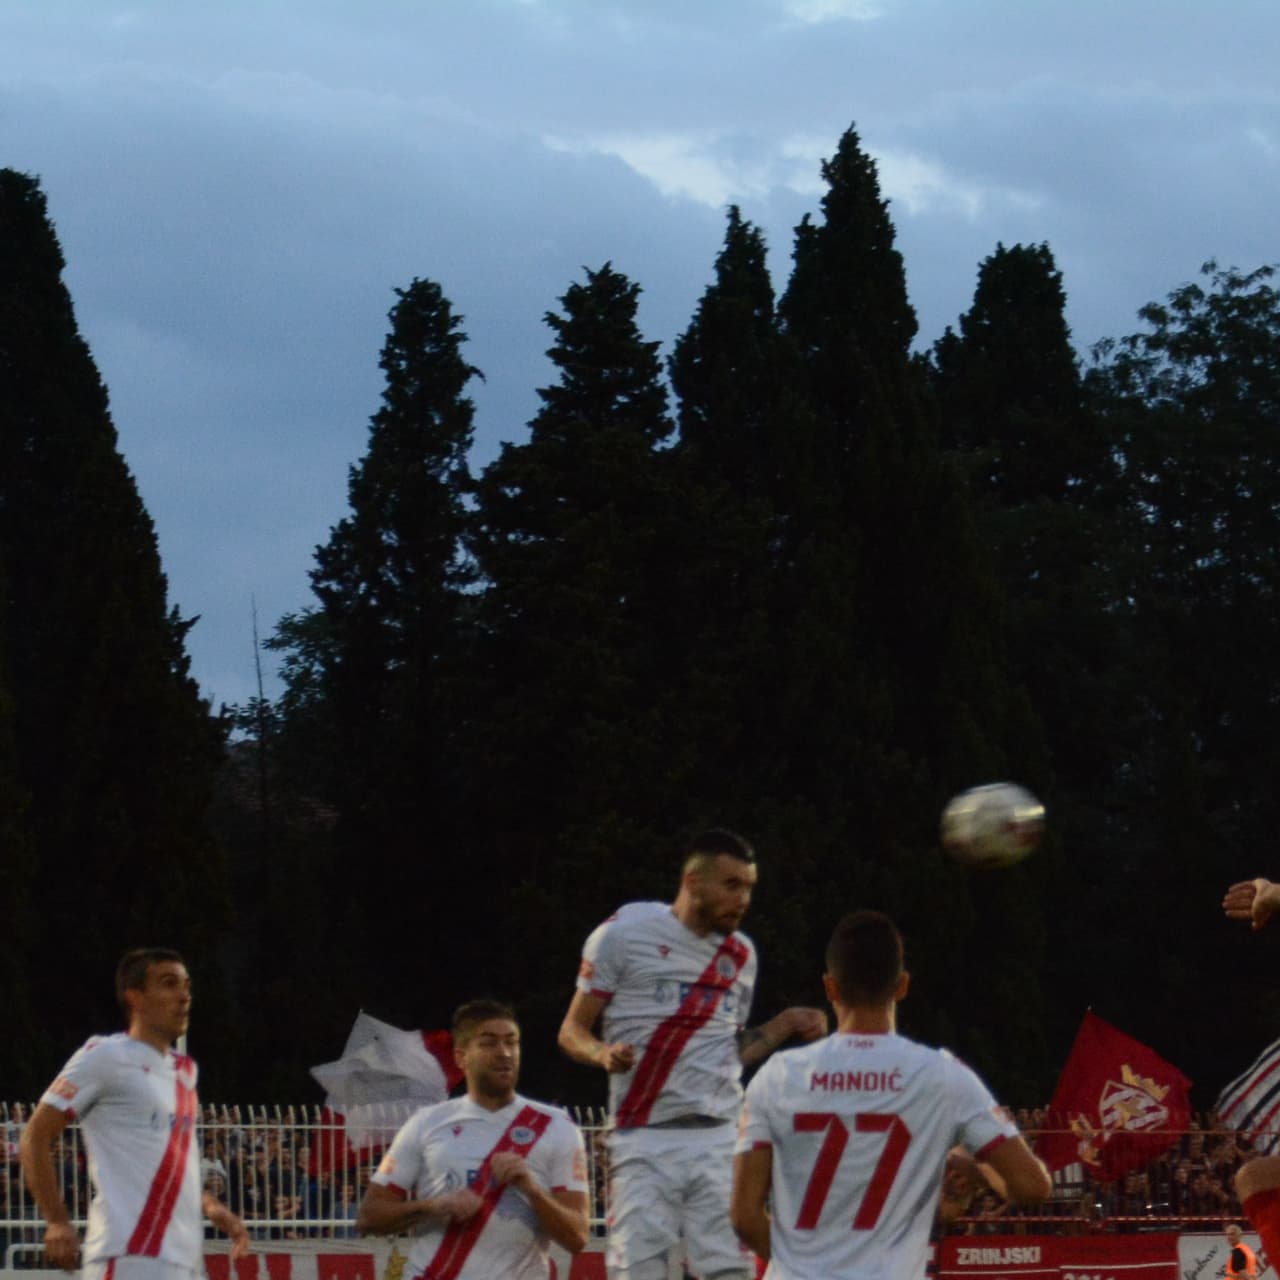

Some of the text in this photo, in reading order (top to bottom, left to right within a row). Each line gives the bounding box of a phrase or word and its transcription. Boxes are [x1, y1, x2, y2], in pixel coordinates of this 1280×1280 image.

[811, 1067, 903, 1092] MANDIĆ
[794, 1113, 912, 1230] 77
[957, 1246, 1041, 1265] ZRINJSKI
